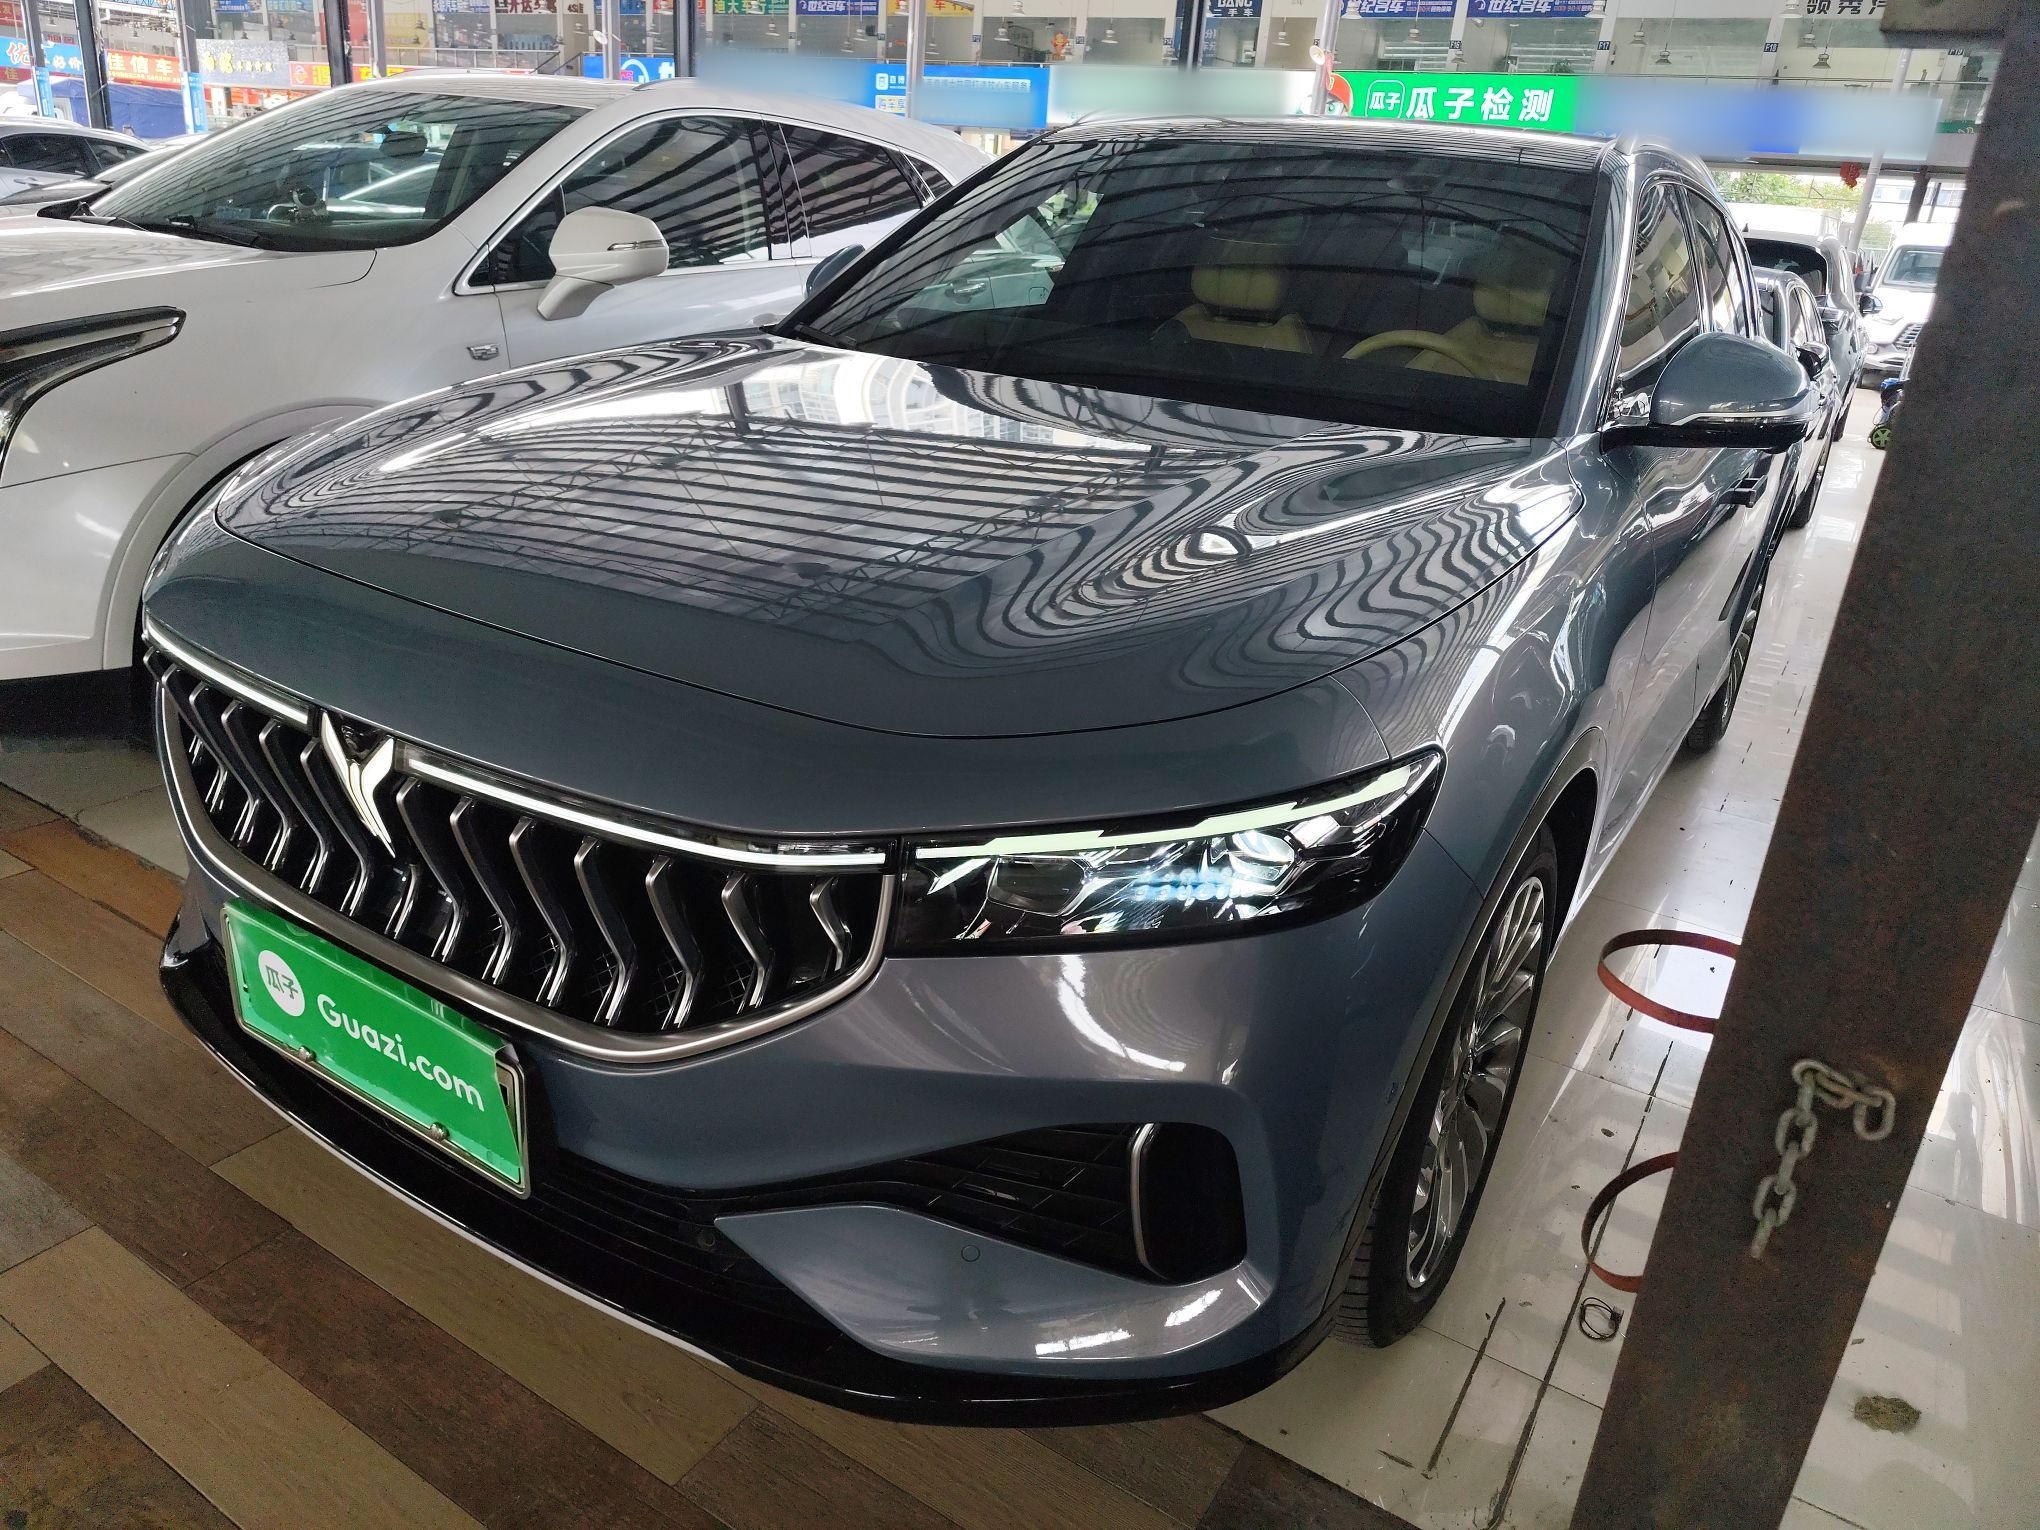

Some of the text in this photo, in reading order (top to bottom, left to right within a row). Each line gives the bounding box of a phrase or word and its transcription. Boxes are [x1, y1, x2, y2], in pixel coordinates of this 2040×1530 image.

[1214, 8, 1254, 17] 二手车
[1487, 0, 1554, 13] 世纪名车
[1598, 42, 1610, 50] F17
[1369, 92, 1402, 111] 瓜子
[1405, 86, 1555, 122] 瓜子检测
[264, 965, 299, 999] 瓜子
[316, 993, 485, 1112] Guazi.com
